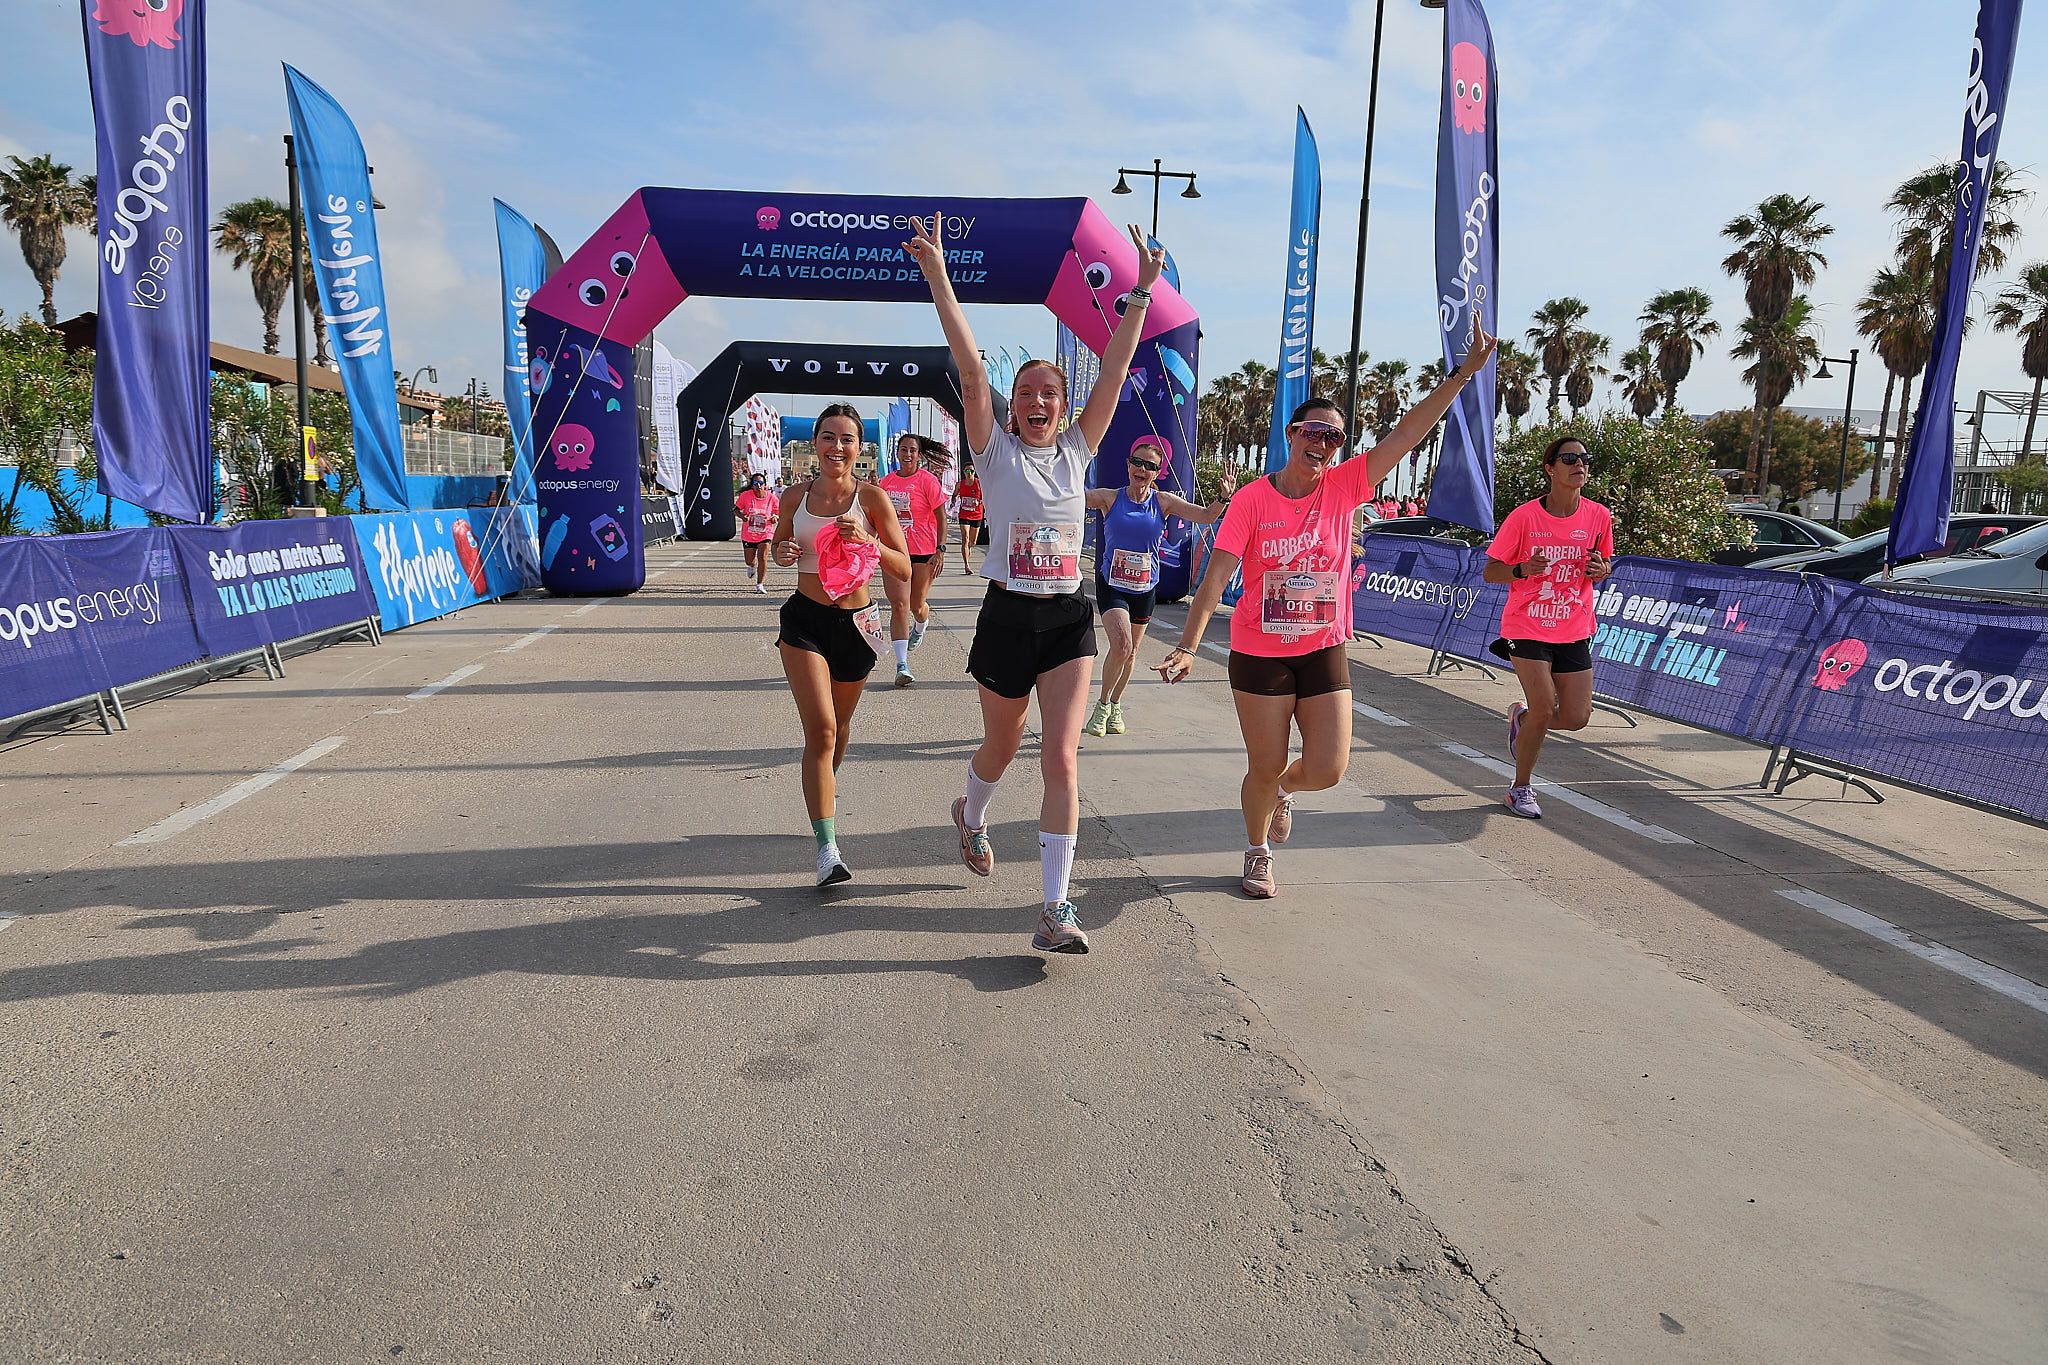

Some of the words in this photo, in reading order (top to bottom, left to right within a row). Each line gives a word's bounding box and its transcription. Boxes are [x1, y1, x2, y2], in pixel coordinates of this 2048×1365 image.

[790, 210, 889, 234] octopus
[741, 243, 765, 257] LA
[769, 243, 850, 260] ENERGÍA
[855, 247, 905, 262] PARA
[740, 264, 752, 276] A
[758, 264, 781, 277] LA
[787, 265, 891, 280] VELOCIDAD
[895, 269, 920, 281] DE
[951, 270, 988, 283] LUZ
[768, 358, 920, 376] VOLVO
[697, 416, 713, 526] VOLVO
[539, 479, 578, 491] octopus
[578, 479, 620, 491] energy
[1262, 528, 1323, 558] CARRERA
[208, 549, 248, 581] Solo
[247, 549, 281, 575] unos
[279, 543, 323, 570] metros
[373, 518, 460, 625] Marlene
[1033, 555, 1062, 567] 016
[1124, 568, 1141, 577] 016
[217, 585, 245, 617] YA
[240, 581, 267, 614] LO
[262, 576, 294, 609] HAS
[289, 567, 357, 603] CONSEGUIDO
[1016, 581, 1041, 590] OYSHO
[1366, 571, 1426, 602] octopus
[1424, 582, 1481, 619] energy
[77, 580, 161, 625] energy
[1286, 600, 1314, 612] 016
[1528, 601, 1571, 619] MUJER
[1622, 593, 1716, 638] energía
[1651, 636, 1728, 686] FINAL
[1873, 658, 2048, 721] octopu
